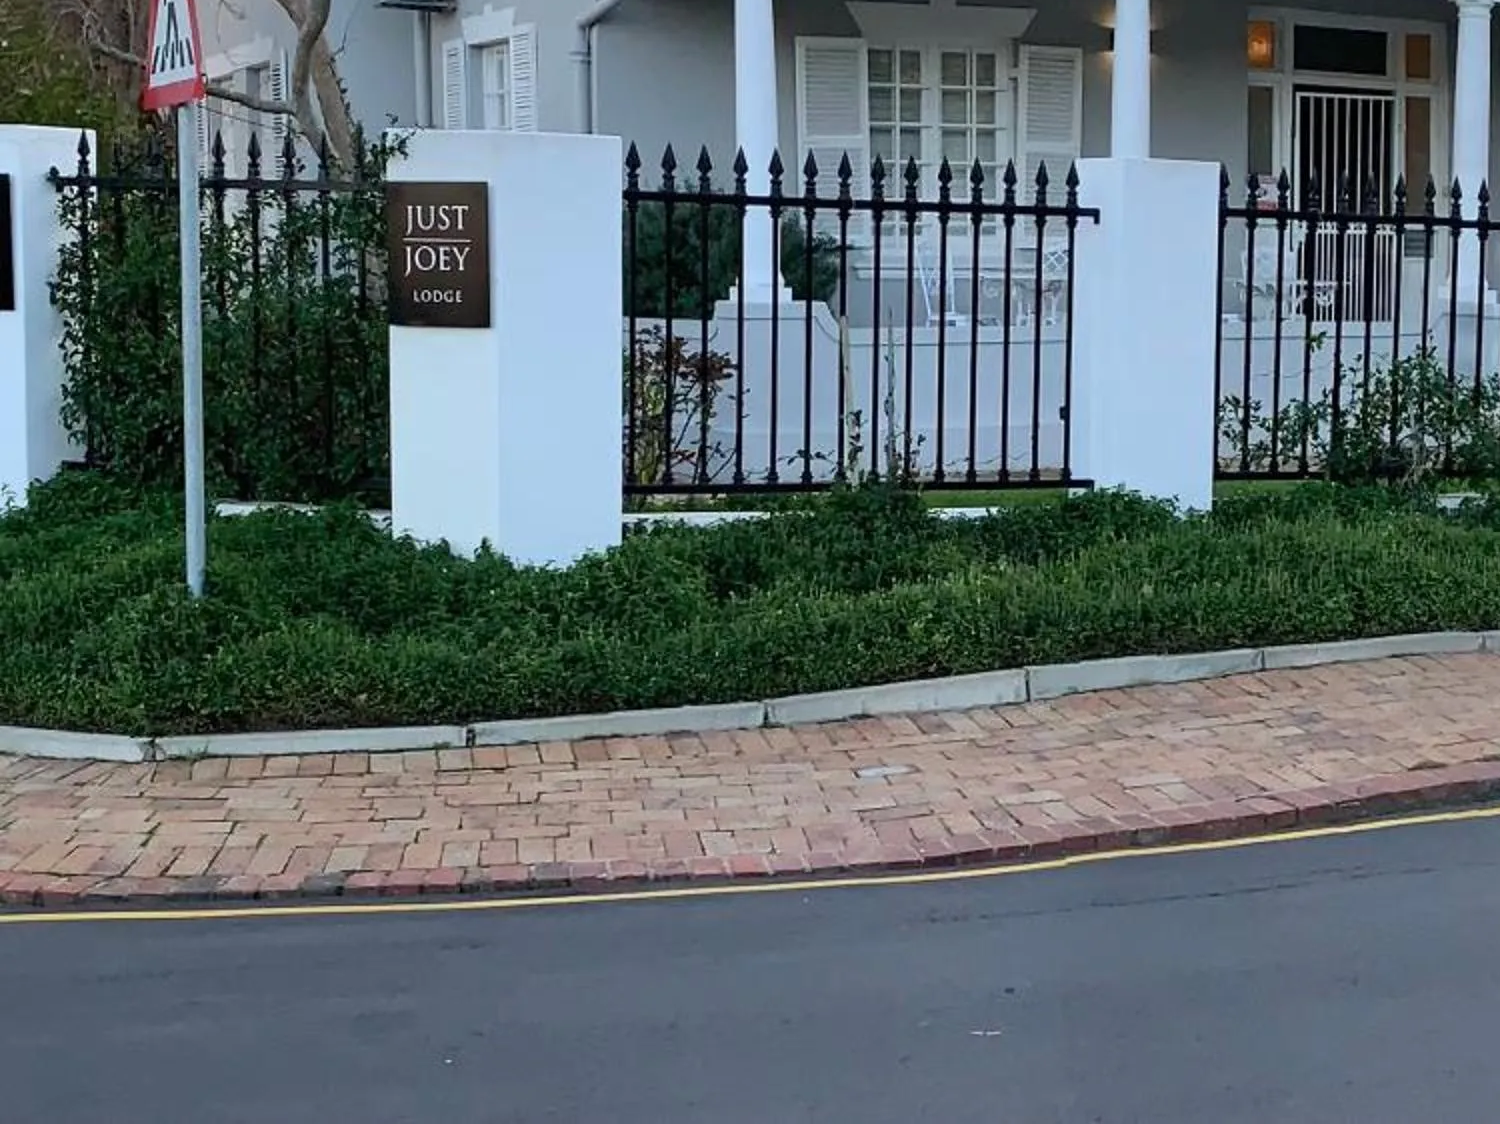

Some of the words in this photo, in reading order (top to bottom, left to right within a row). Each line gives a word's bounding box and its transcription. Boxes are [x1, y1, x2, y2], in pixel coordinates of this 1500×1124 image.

[406, 204, 469, 236] JUST
[404, 245, 471, 277] JOEY
[413, 289, 463, 303] LODGE
